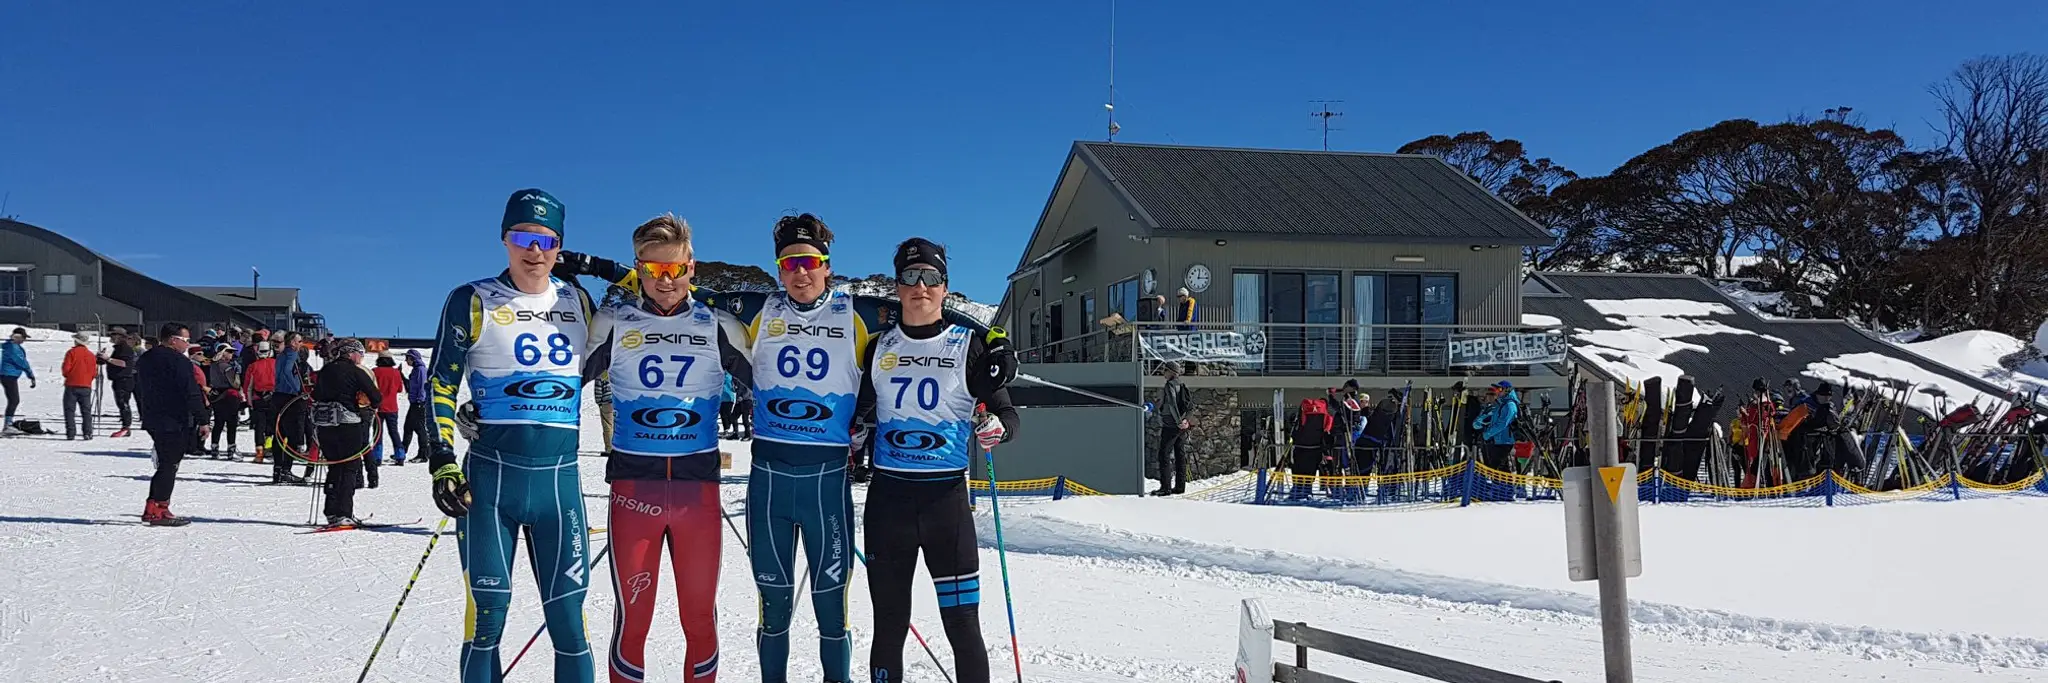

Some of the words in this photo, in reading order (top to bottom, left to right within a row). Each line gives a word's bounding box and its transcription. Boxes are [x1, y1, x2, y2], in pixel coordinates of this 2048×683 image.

[516, 310, 577, 323] SKINS
[644, 333, 708, 346] SKINS
[787, 324, 845, 339] SKINS
[514, 332, 573, 367] 68
[1450, 333, 1547, 359] PERISHER
[638, 354, 696, 389] 67
[776, 345, 830, 381] 69
[898, 356, 955, 369] SKINS
[889, 376, 940, 411] 70
[509, 404, 572, 414] SALOMON
[632, 431, 698, 441] SALOMON
[768, 421, 828, 434] SALOMON
[566, 507, 583, 558] FallsCreek
[828, 513, 842, 560] FallsCreek
